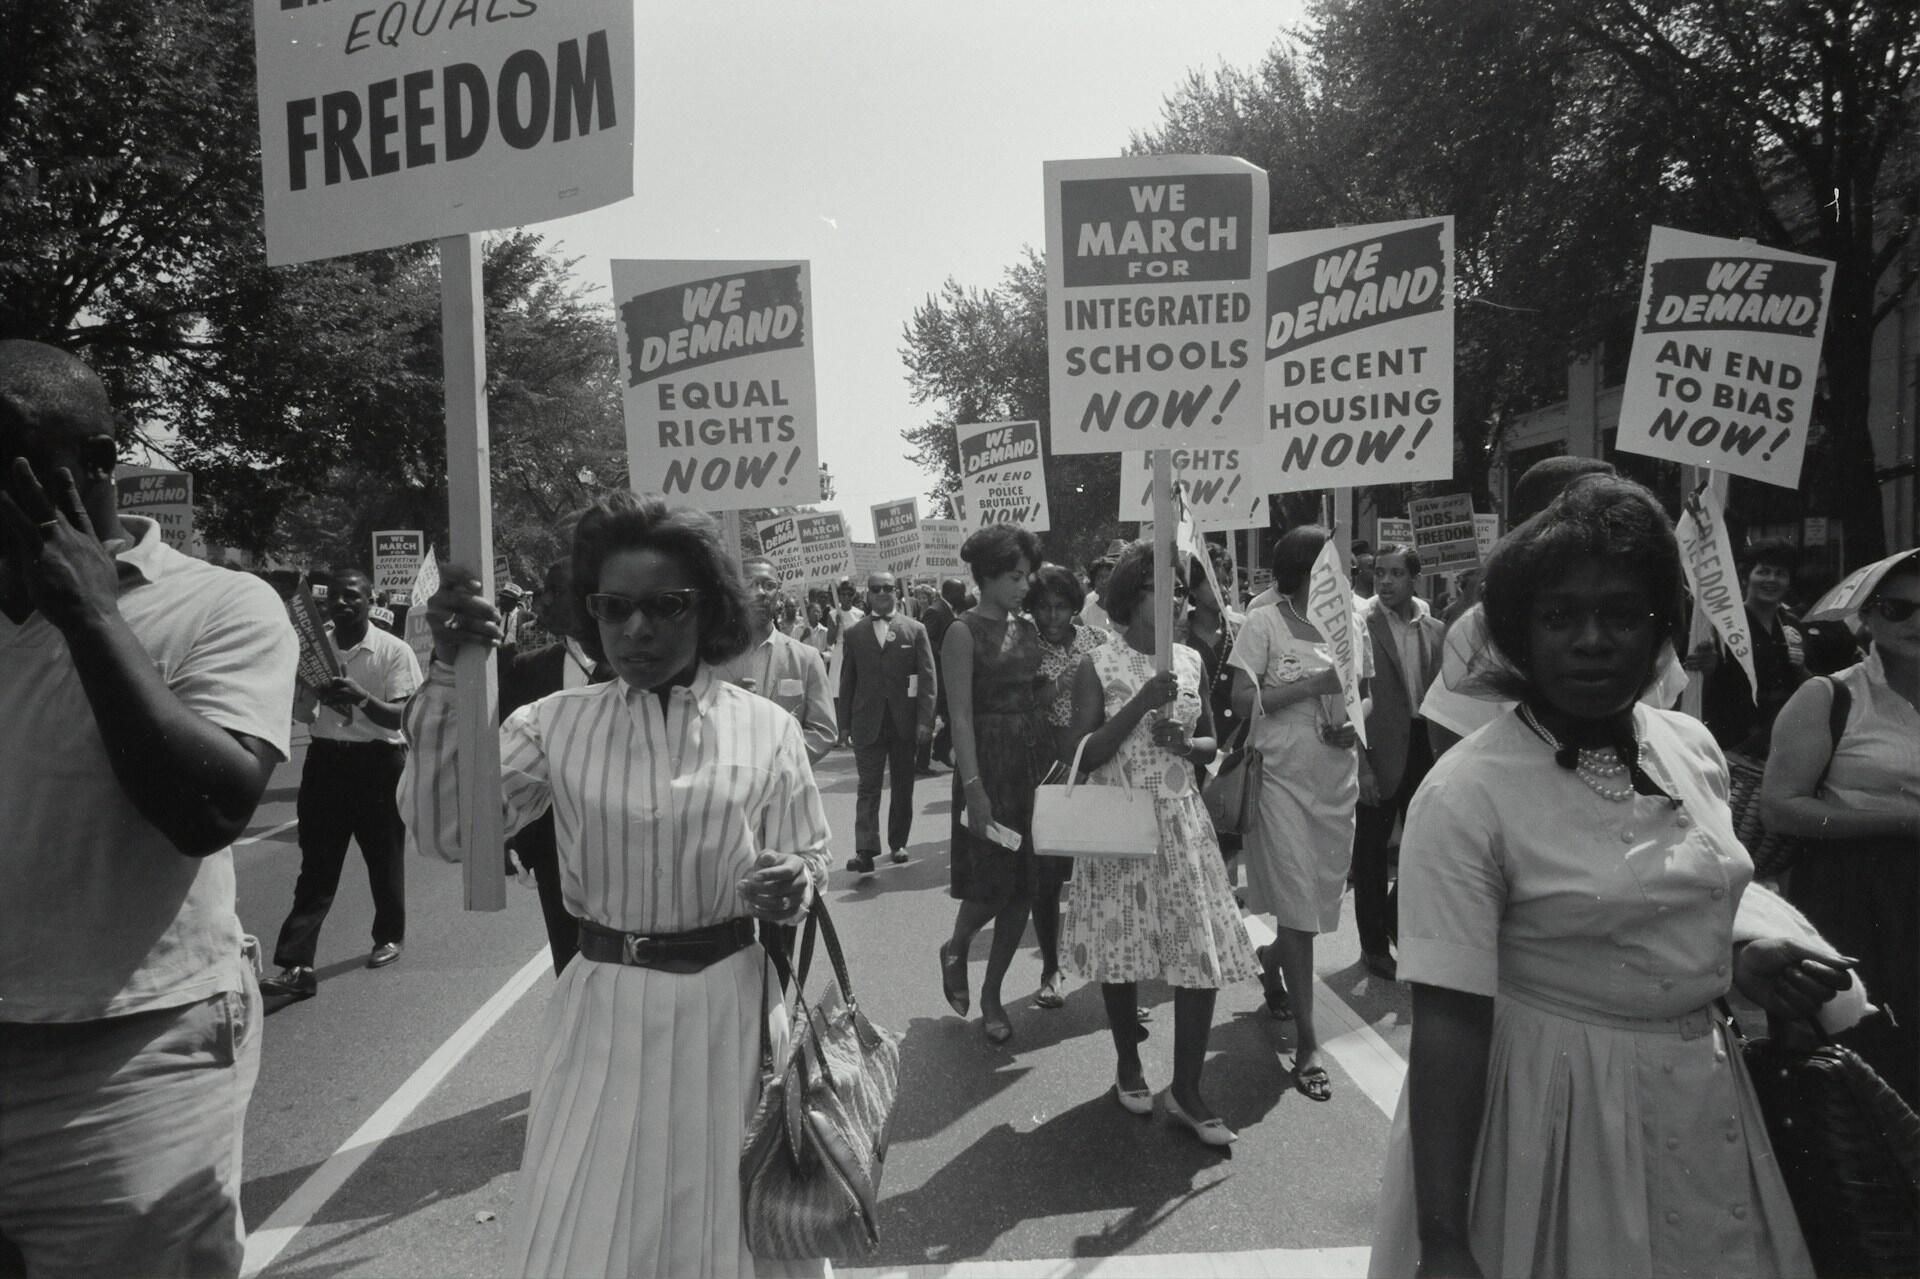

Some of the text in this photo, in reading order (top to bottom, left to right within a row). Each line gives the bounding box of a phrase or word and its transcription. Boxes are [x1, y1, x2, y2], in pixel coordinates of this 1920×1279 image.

[286, 29, 617, 191] FREEDOM
[1130, 184, 1186, 213] WE
[1077, 217, 1238, 257] MARCH
[1128, 260, 1190, 278] FOR
[1313, 243, 1383, 294] WE
[1706, 261, 1773, 291] WE
[682, 278, 746, 322] WE
[1064, 292, 1251, 331] INTEGRATED
[1266, 266, 1439, 350] DEMAND
[1655, 293, 1815, 326] DEMAND
[640, 305, 798, 372] DEMAND
[1066, 339, 1249, 377] SCHOOLS
[1283, 347, 1428, 387] DECENT
[1655, 340, 1802, 390] AN END
[658, 380, 788, 411] EQUAL
[1080, 379, 1241, 433] NOW!
[1656, 372, 1795, 424] TO BIAS
[1269, 388, 1442, 430] HOUSING
[658, 415, 795, 448] RIGHTS
[985, 428, 1013, 449] WE
[1649, 408, 1791, 461] NOW!
[968, 438, 1035, 472] DEMAND
[1282, 418, 1434, 473] NOW!
[662, 446, 801, 495] NOW!
[1144, 449, 1239, 470] RGHTS
[139, 475, 168, 490] WE
[975, 470, 1032, 484] AN END
[121, 487, 187, 506] DEMAND
[979, 495, 1032, 509] BRUTALITY
[988, 485, 1024, 497] POLICE
[812, 518, 826, 526] WE
[879, 512, 913, 529] MARCH
[889, 507, 901, 516] WE
[980, 501, 1041, 526] NOW!
[1415, 511, 1453, 529] JOBS
[391, 535, 404, 543] WE
[774, 520, 791, 534] WE
[802, 523, 840, 537] MARCH
[1416, 525, 1475, 546] FREEDOM
[379, 542, 417, 551] MARCH
[771, 546, 799, 557] AN EN
[802, 540, 847, 554] INTEGRATED
[879, 533, 920, 550] FIRST CLASS
[879, 543, 921, 560] CITIZENSHIP
[804, 550, 849, 565] SCHOOLS
[811, 559, 849, 577] NOW!
[887, 555, 921, 573] NOW!
[290, 593, 314, 635] MARCH
[1309, 562, 1350, 668] FREEDOM
